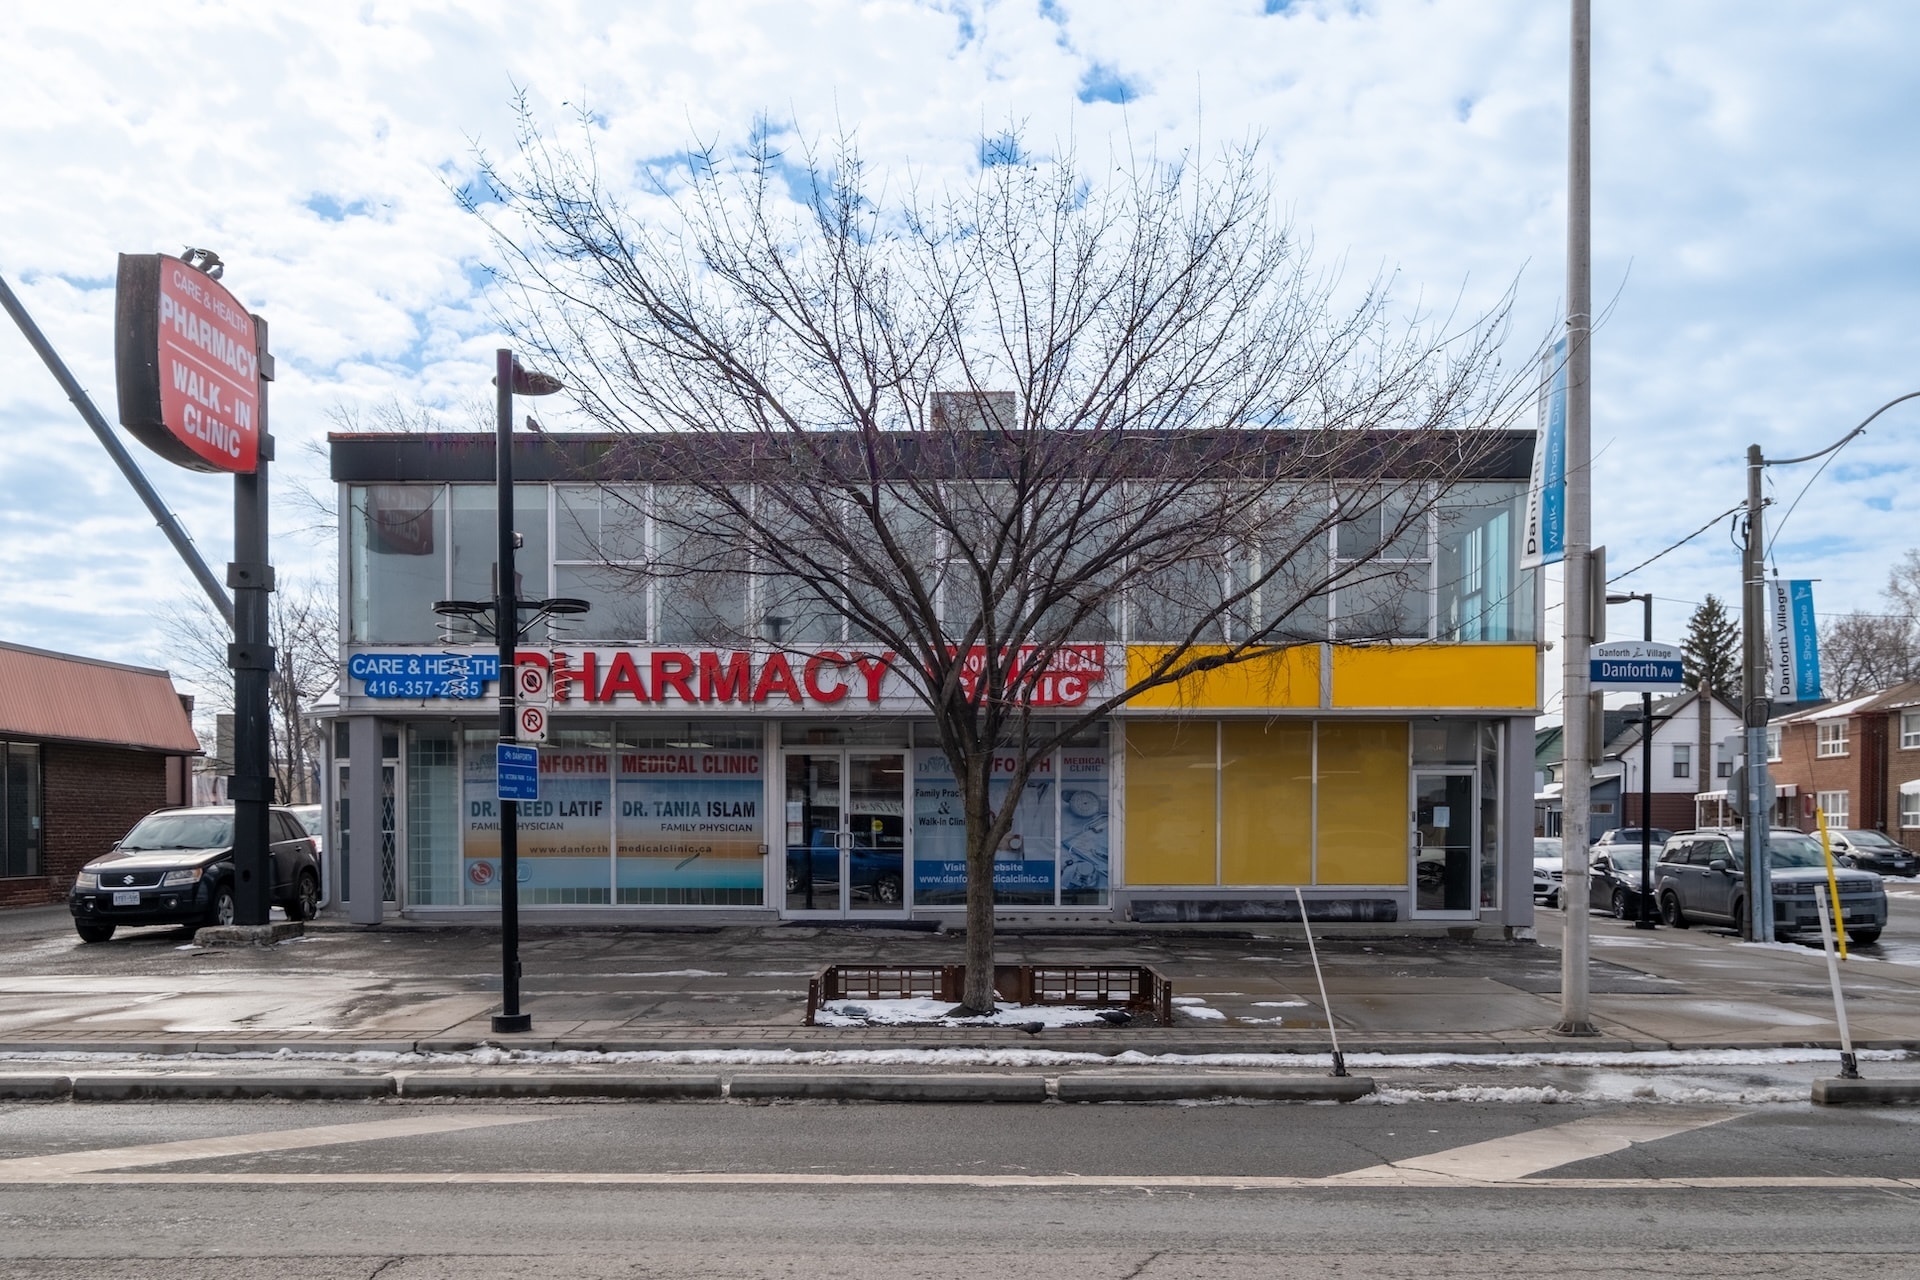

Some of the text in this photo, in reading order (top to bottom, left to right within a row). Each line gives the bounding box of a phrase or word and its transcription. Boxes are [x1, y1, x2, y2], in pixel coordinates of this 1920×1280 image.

[173, 269, 248, 336] CARE & HEALTH
[161, 292, 258, 382] PHARMACY
[172, 360, 221, 414] WALK
[234, 399, 251, 430] IN
[183, 403, 241, 458] CLINIC
[1550, 505, 1558, 549] Walk
[1777, 588, 1790, 696] Danforth Village
[1801, 604, 1814, 693] Walk Shop Dine
[1598, 648, 1672, 659] Danforth Village
[352, 658, 496, 675] CARE & HEALTH
[1602, 662, 1674, 678] Danforth Av
[539, 754, 759, 774] NFORTH MEDICAL CLINIC
[1063, 757, 1106, 772] MEDICAL CLINIC
[915, 788, 940, 799] Family
[471, 801, 603, 817] DR. AEED LATIF
[622, 801, 756, 818] DR. TANIA ISLAM
[938, 801, 951, 815] &
[471, 822, 564, 831] FAMIL HYSICIAN
[661, 823, 753, 833] FAMILY PHYSICIAN
[948, 817, 966, 826] Clini
[944, 863, 1023, 872] Visit ebsite
